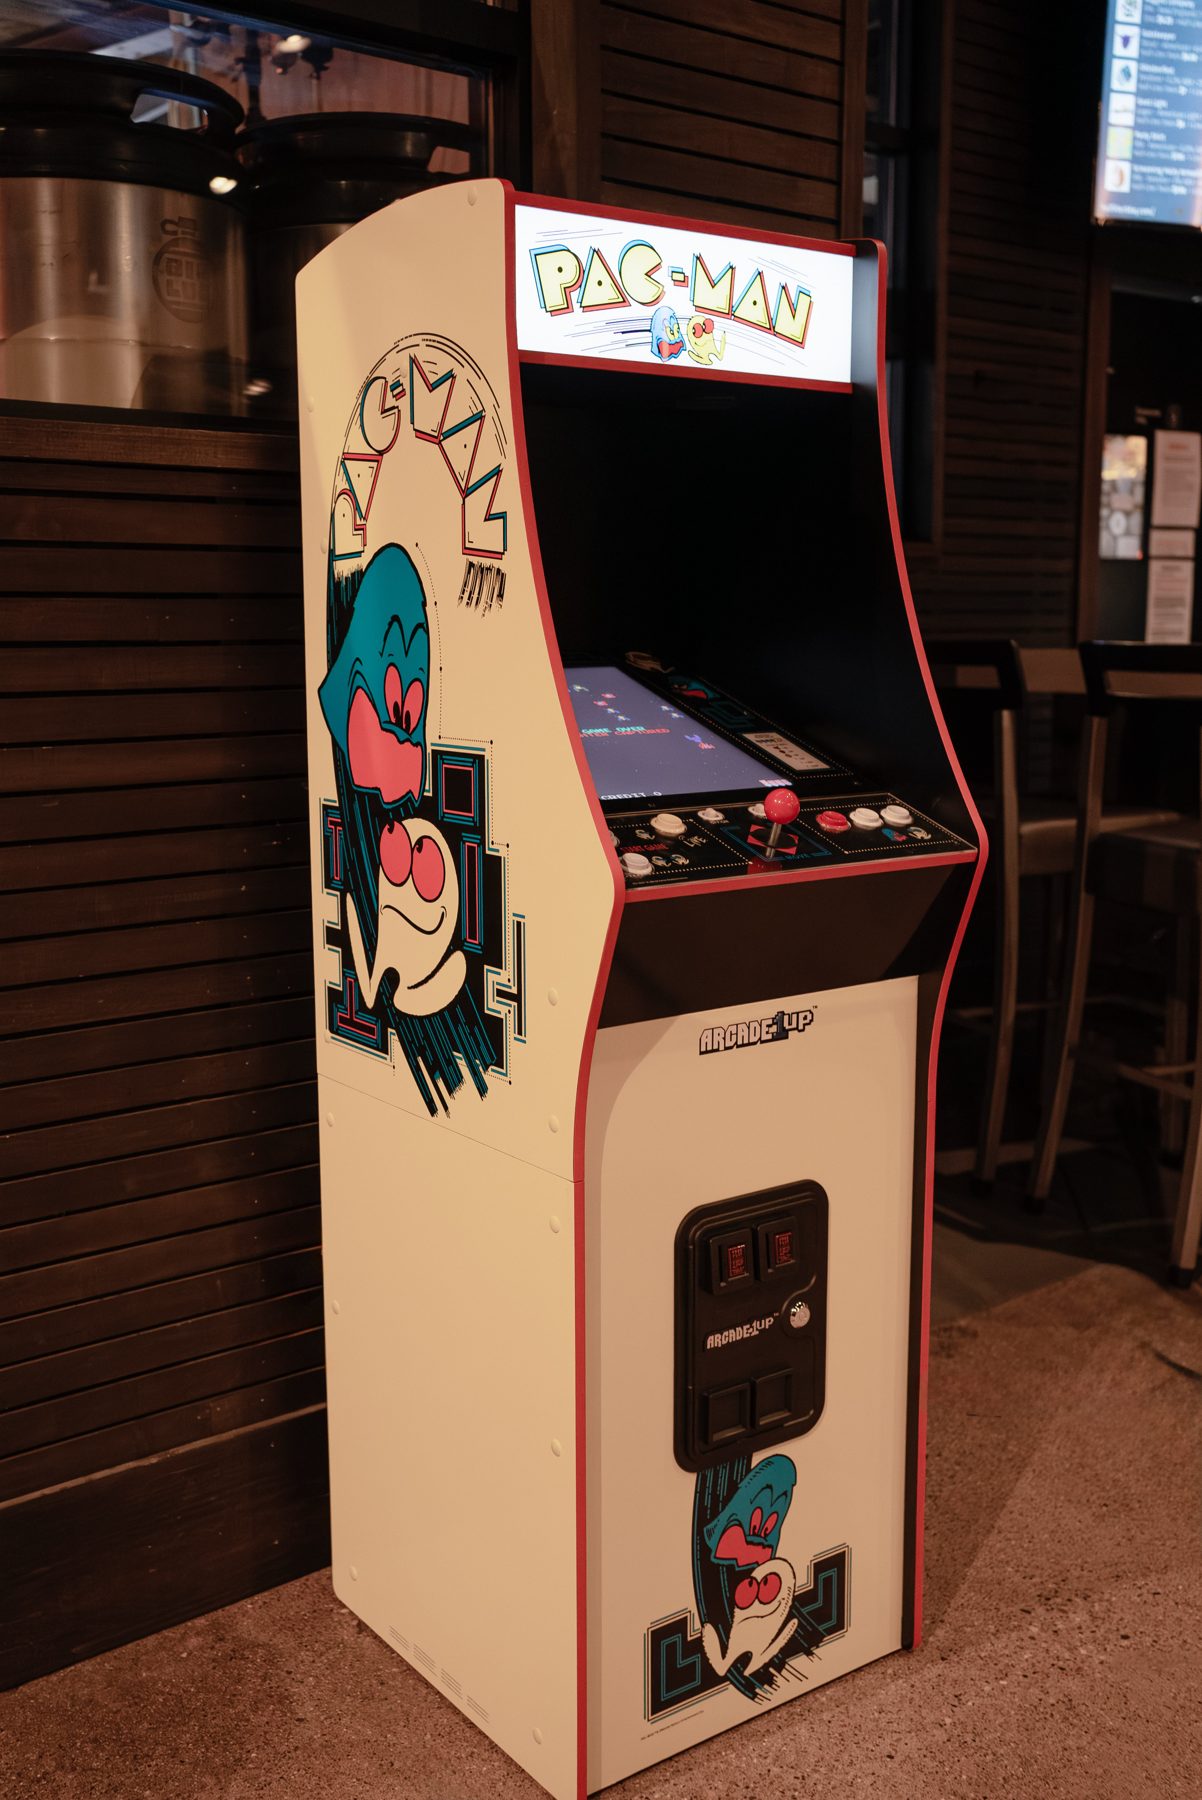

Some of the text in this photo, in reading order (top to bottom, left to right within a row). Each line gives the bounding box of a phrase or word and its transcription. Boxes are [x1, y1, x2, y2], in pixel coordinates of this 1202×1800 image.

[529, 239, 814, 350] PAC-MAN
[331, 352, 508, 562] PAC-MAN
[601, 792, 647, 801] CREDIT
